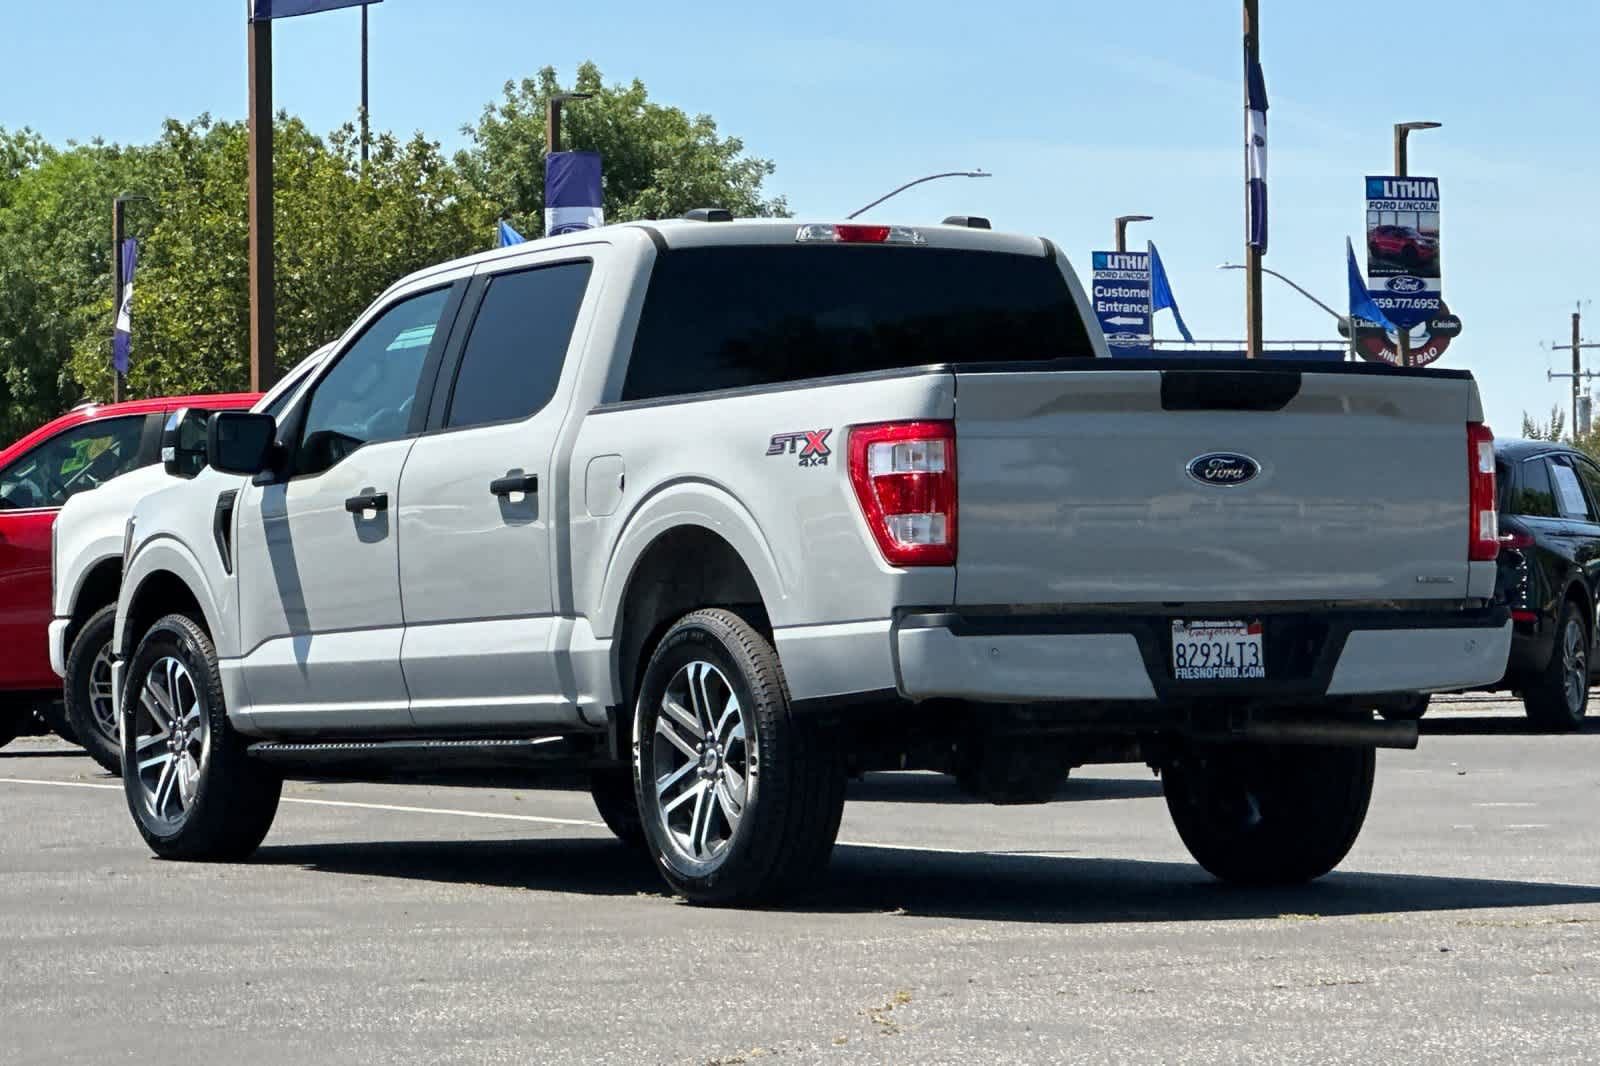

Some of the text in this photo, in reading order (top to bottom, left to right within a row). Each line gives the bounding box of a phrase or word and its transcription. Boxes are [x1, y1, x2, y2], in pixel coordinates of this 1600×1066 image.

[1383, 181, 1437, 198] LITHIA
[1369, 201, 1438, 210] FORD LINCOLN
[1393, 278, 1419, 290] Ford
[1097, 301, 1149, 313] Entrance
[1416, 347, 1438, 364] BAO
[765, 428, 832, 458] STX
[1176, 641, 1260, 668] 82934T3
[1175, 667, 1265, 679] FRESNOFORD.COM
